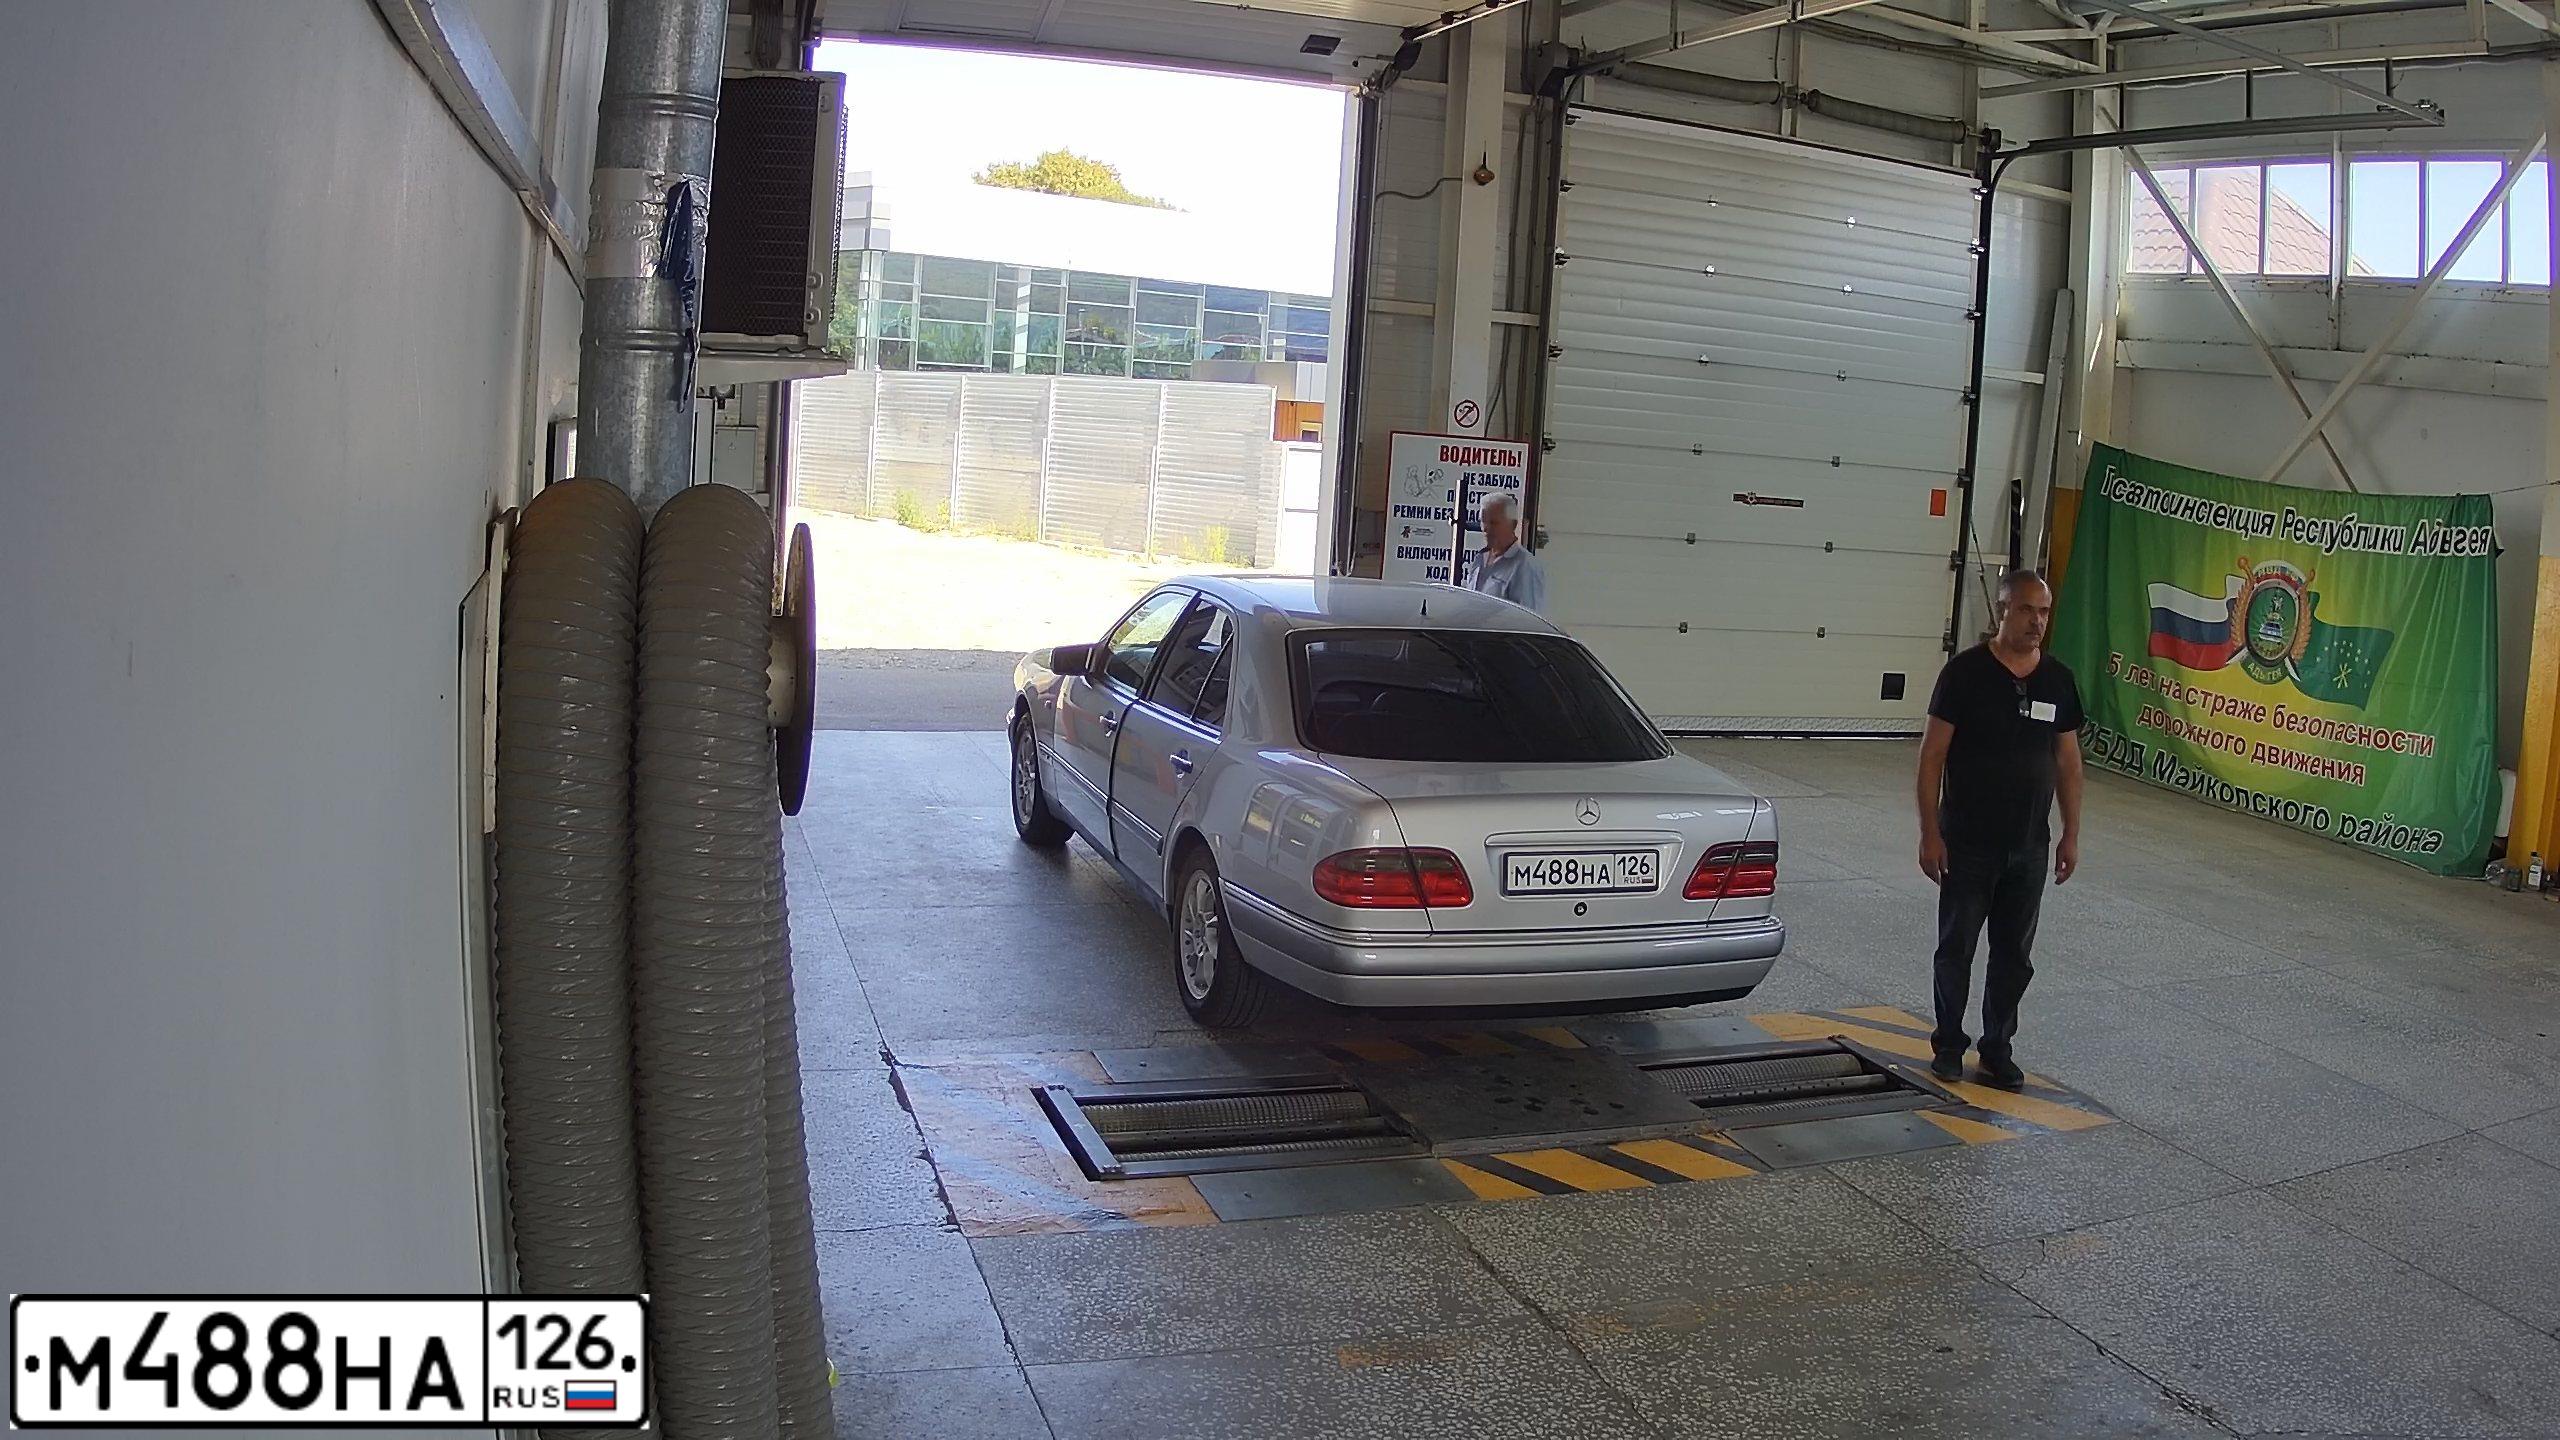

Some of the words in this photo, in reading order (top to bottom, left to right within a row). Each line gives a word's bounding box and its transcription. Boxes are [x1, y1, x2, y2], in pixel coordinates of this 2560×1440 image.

[1440, 445, 1522, 467] ВОДИТЕЛЬ!
[1478, 473, 1519, 489] ЗАБУДЬ
[1394, 505, 1432, 519] РЕМНИ
[2280, 508, 2406, 556] Ресублики
[1397, 546, 1452, 561] ВКЛЮЧИТ
[2185, 686, 2267, 725] страже
[2272, 703, 2435, 758] безопасности
[2136, 704, 2247, 756] дорожного
[2250, 741, 2366, 788] движения
[2078, 716, 2147, 777] ИБДД
[2151, 748, 2331, 832] Майкопского
[2336, 811, 2444, 854] района
[1514, 859, 1610, 886] М488НА
[1617, 855, 1650, 876] 126
[1623, 877, 1641, 885] RUS
